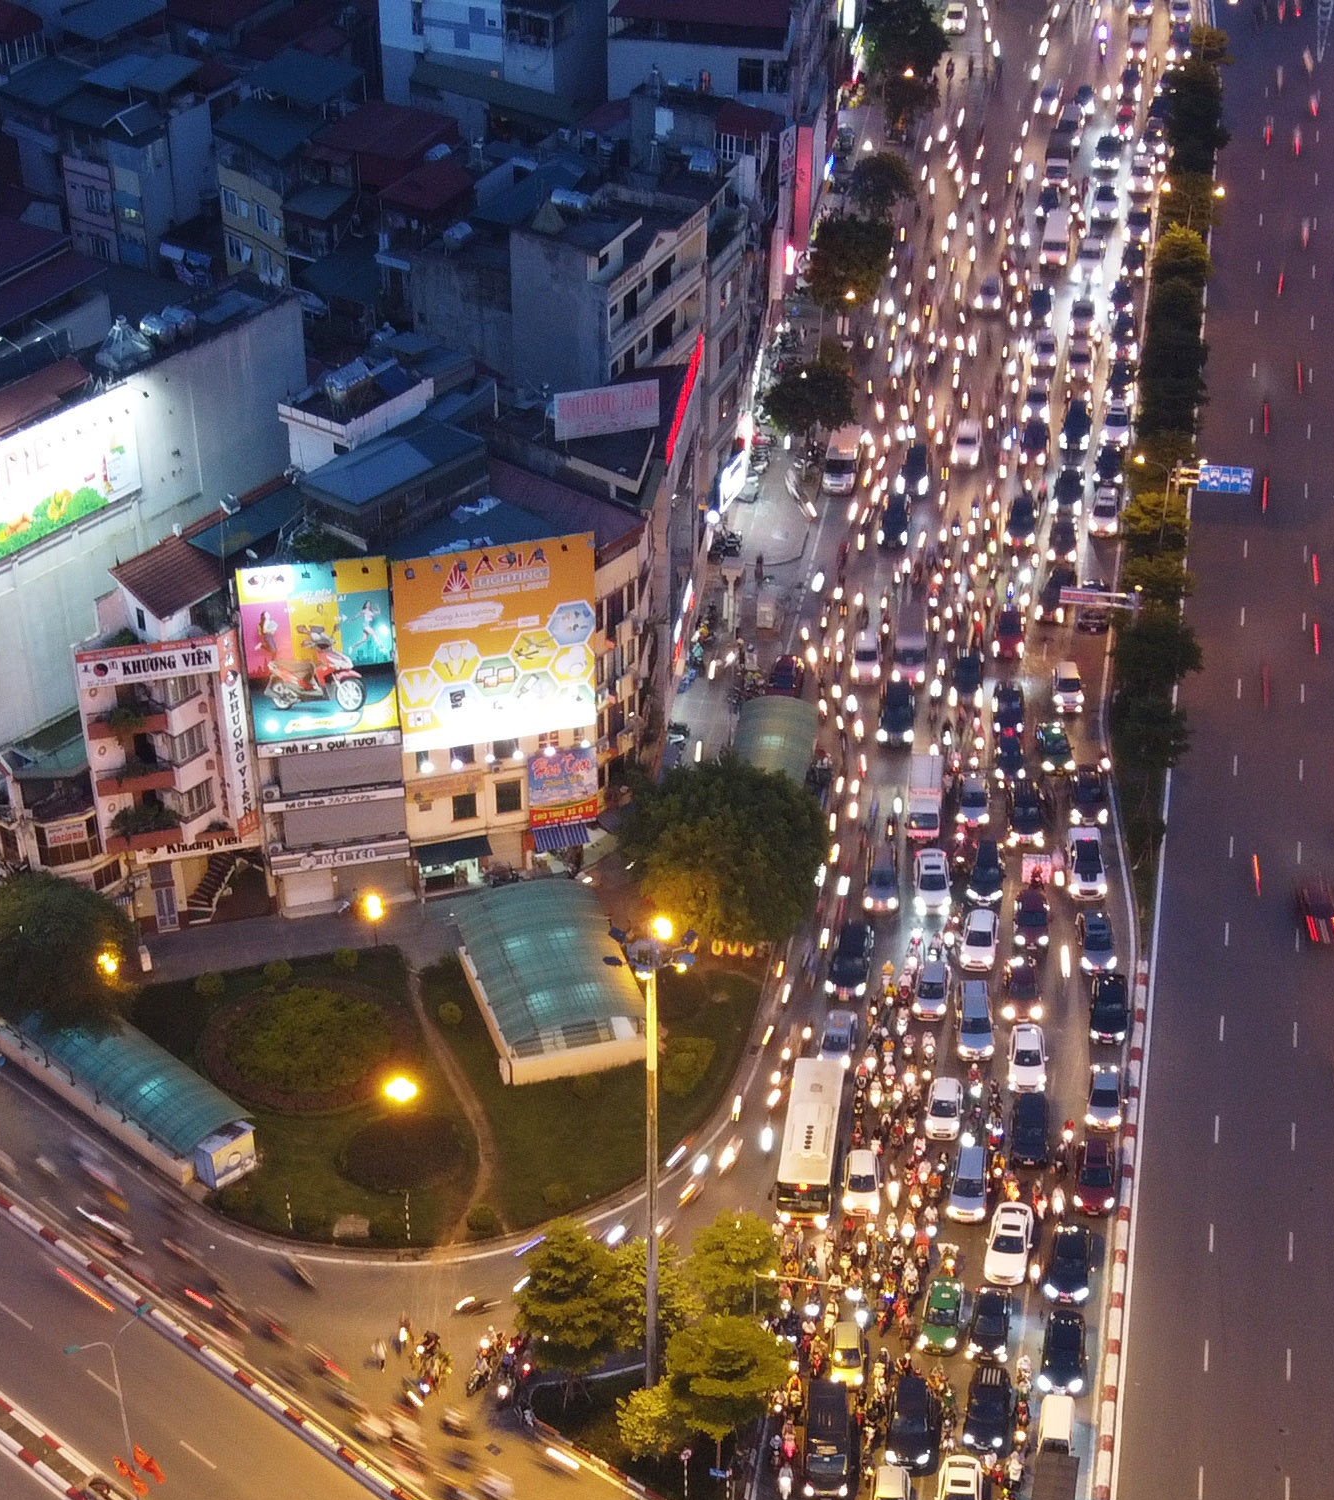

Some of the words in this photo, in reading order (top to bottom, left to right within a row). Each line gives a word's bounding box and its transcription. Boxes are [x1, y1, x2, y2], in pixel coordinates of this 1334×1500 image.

[473, 549, 548, 575] ASIA
[478, 571, 544, 587] LIGHTING
[122, 654, 177, 676] KHƯƠNG
[182, 648, 213, 666] VIÊN
